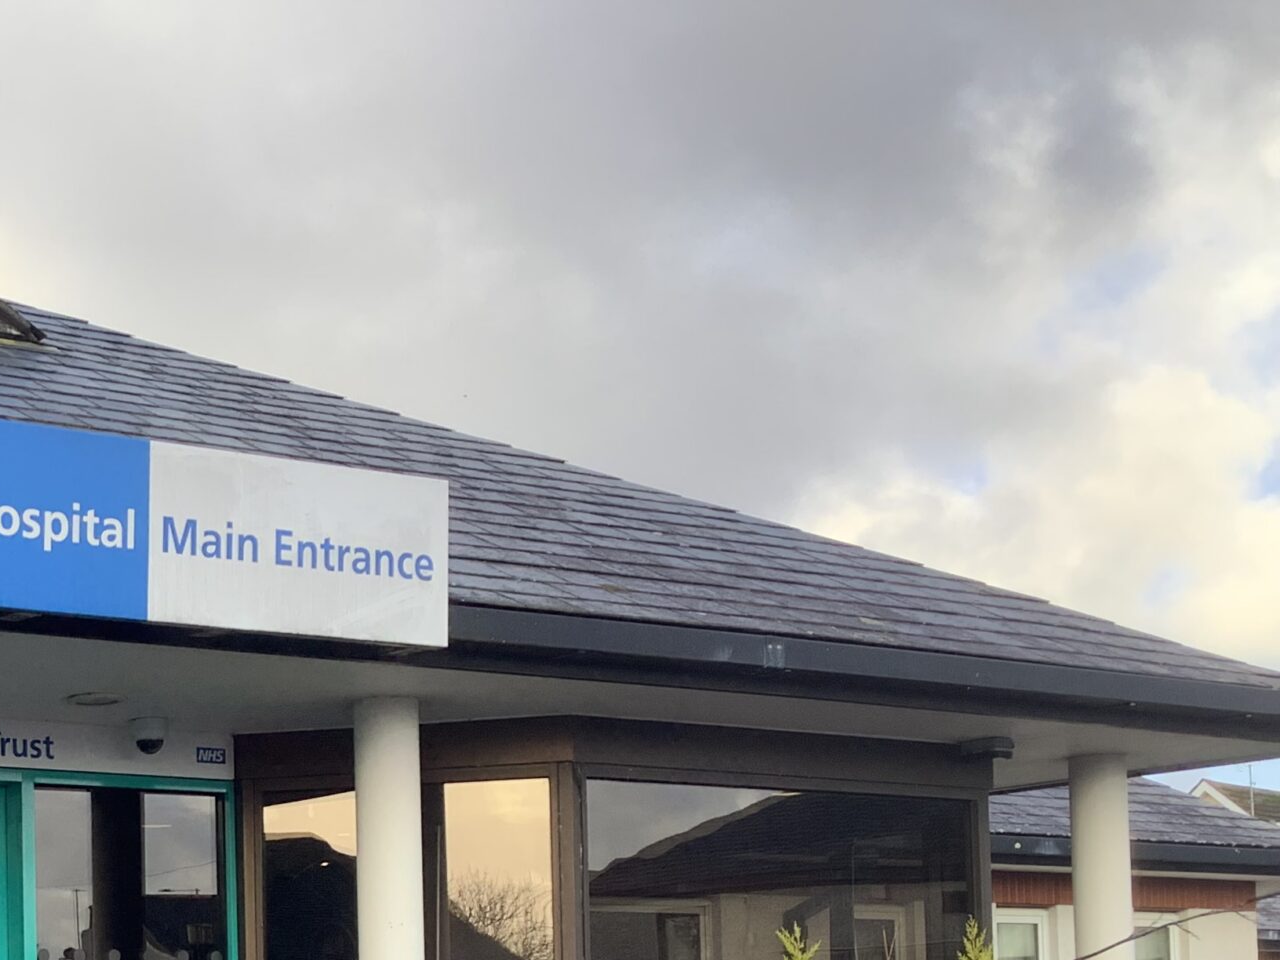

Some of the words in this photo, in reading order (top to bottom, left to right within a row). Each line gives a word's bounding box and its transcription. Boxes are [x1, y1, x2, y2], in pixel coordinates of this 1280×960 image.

[162, 516, 259, 563] Main
[274, 528, 434, 581] Entrance
[198, 749, 224, 762] NHS
